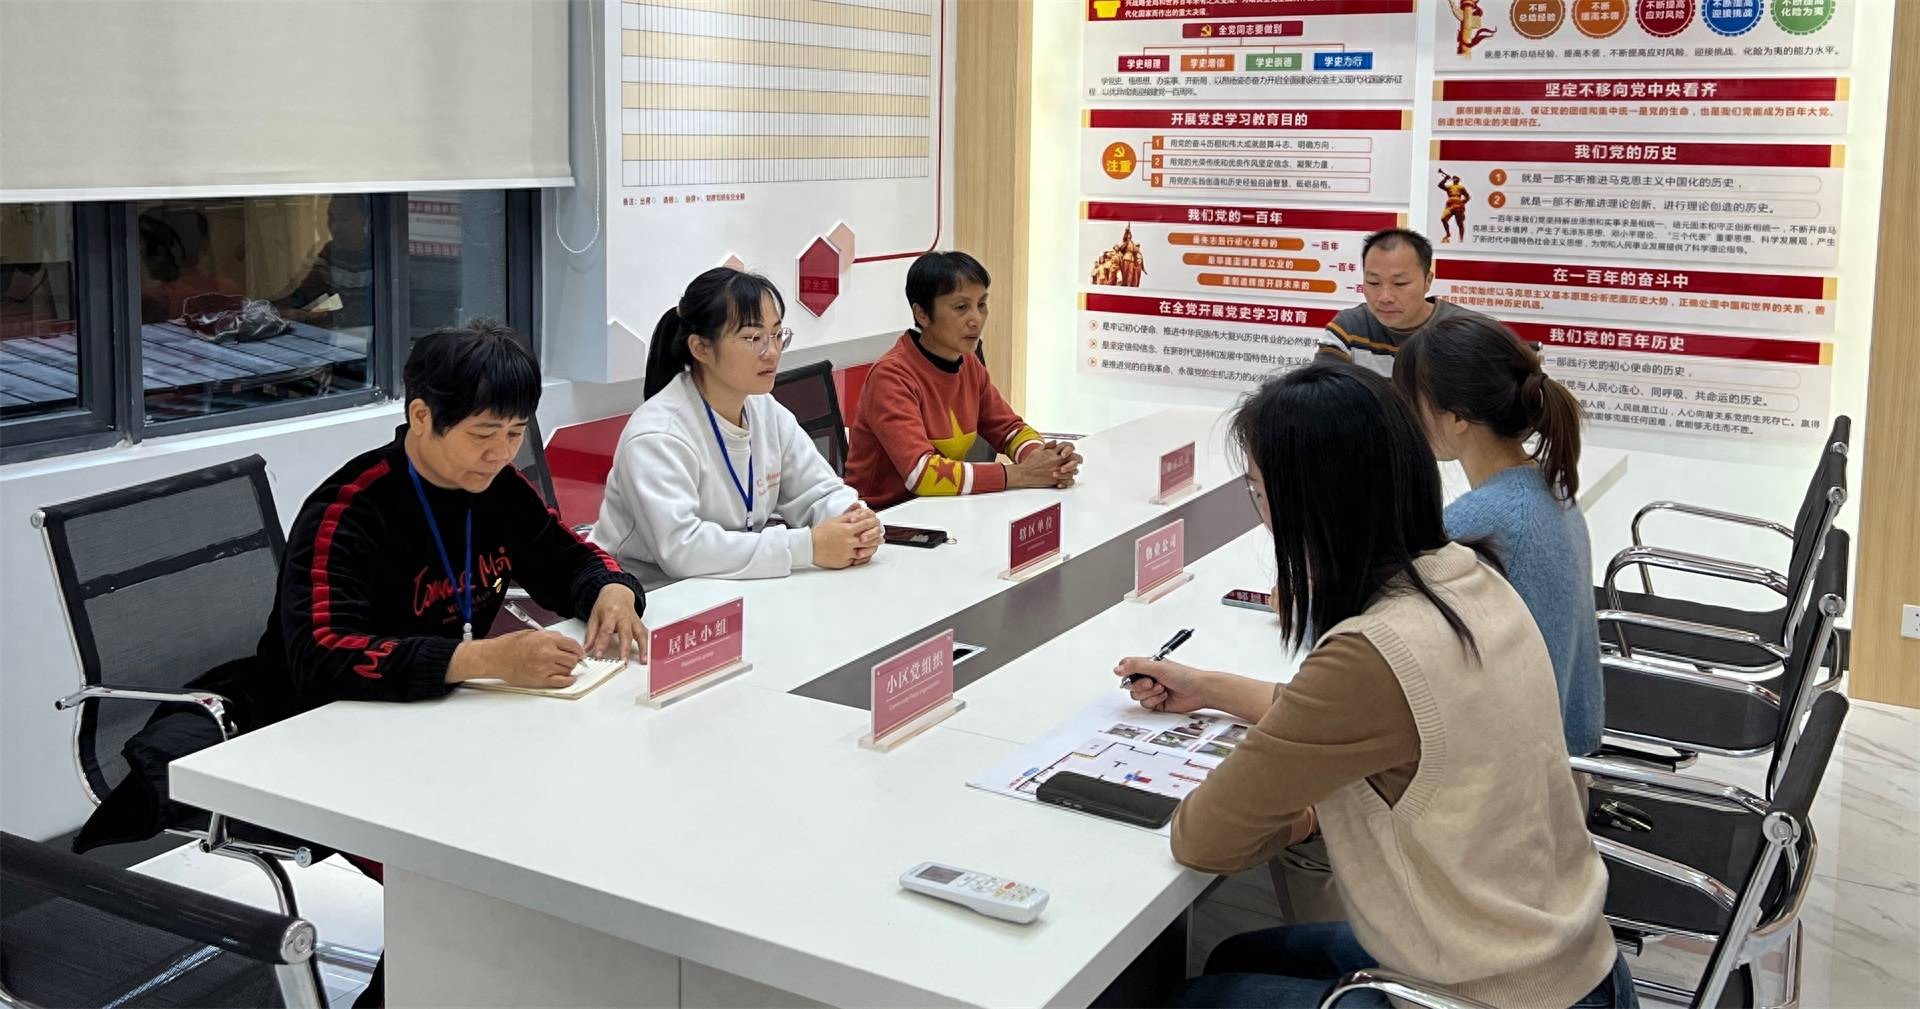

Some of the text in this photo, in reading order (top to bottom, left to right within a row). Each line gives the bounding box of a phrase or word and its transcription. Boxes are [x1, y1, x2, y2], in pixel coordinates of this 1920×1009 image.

[1528, 3, 1548, 12] 不断
[1591, 1, 1611, 11] 不断
[1781, 7, 1825, 17] 化险为夷
[1518, 12, 1557, 22] 总结经验
[1581, 11, 1620, 21] 提高本领
[1645, 10, 1686, 19] 应对风险
[1712, 9, 1753, 18] 迎接挑战
[1218, 23, 1282, 36] 全党同志要做到
[1126, 58, 1161, 70] 学史明理
[1190, 58, 1226, 69] 学史增信
[1255, 57, 1293, 68] 学史崇德
[1324, 56, 1363, 67] 学史力行
[1545, 82, 1718, 98] 坚定不移向党中央看齐
[1170, 112, 1308, 127] 开展党史学习教育目的
[1574, 144, 1678, 161] 我们党的历史
[1106, 159, 1132, 173] 注重
[1187, 208, 1283, 224] 我们党的一百年
[1311, 241, 1340, 251] 一百年
[1329, 262, 1357, 272] 一百年
[1553, 267, 1689, 289] 在一百年的奋斗中
[1159, 300, 1308, 324] 在全党开展党史学习教育
[1550, 328, 1685, 351] 我们党的百年历史
[1019, 515, 1053, 542] 辖区单位
[667, 617, 728, 656] 居民小组
[886, 650, 944, 694] 小区党组织
